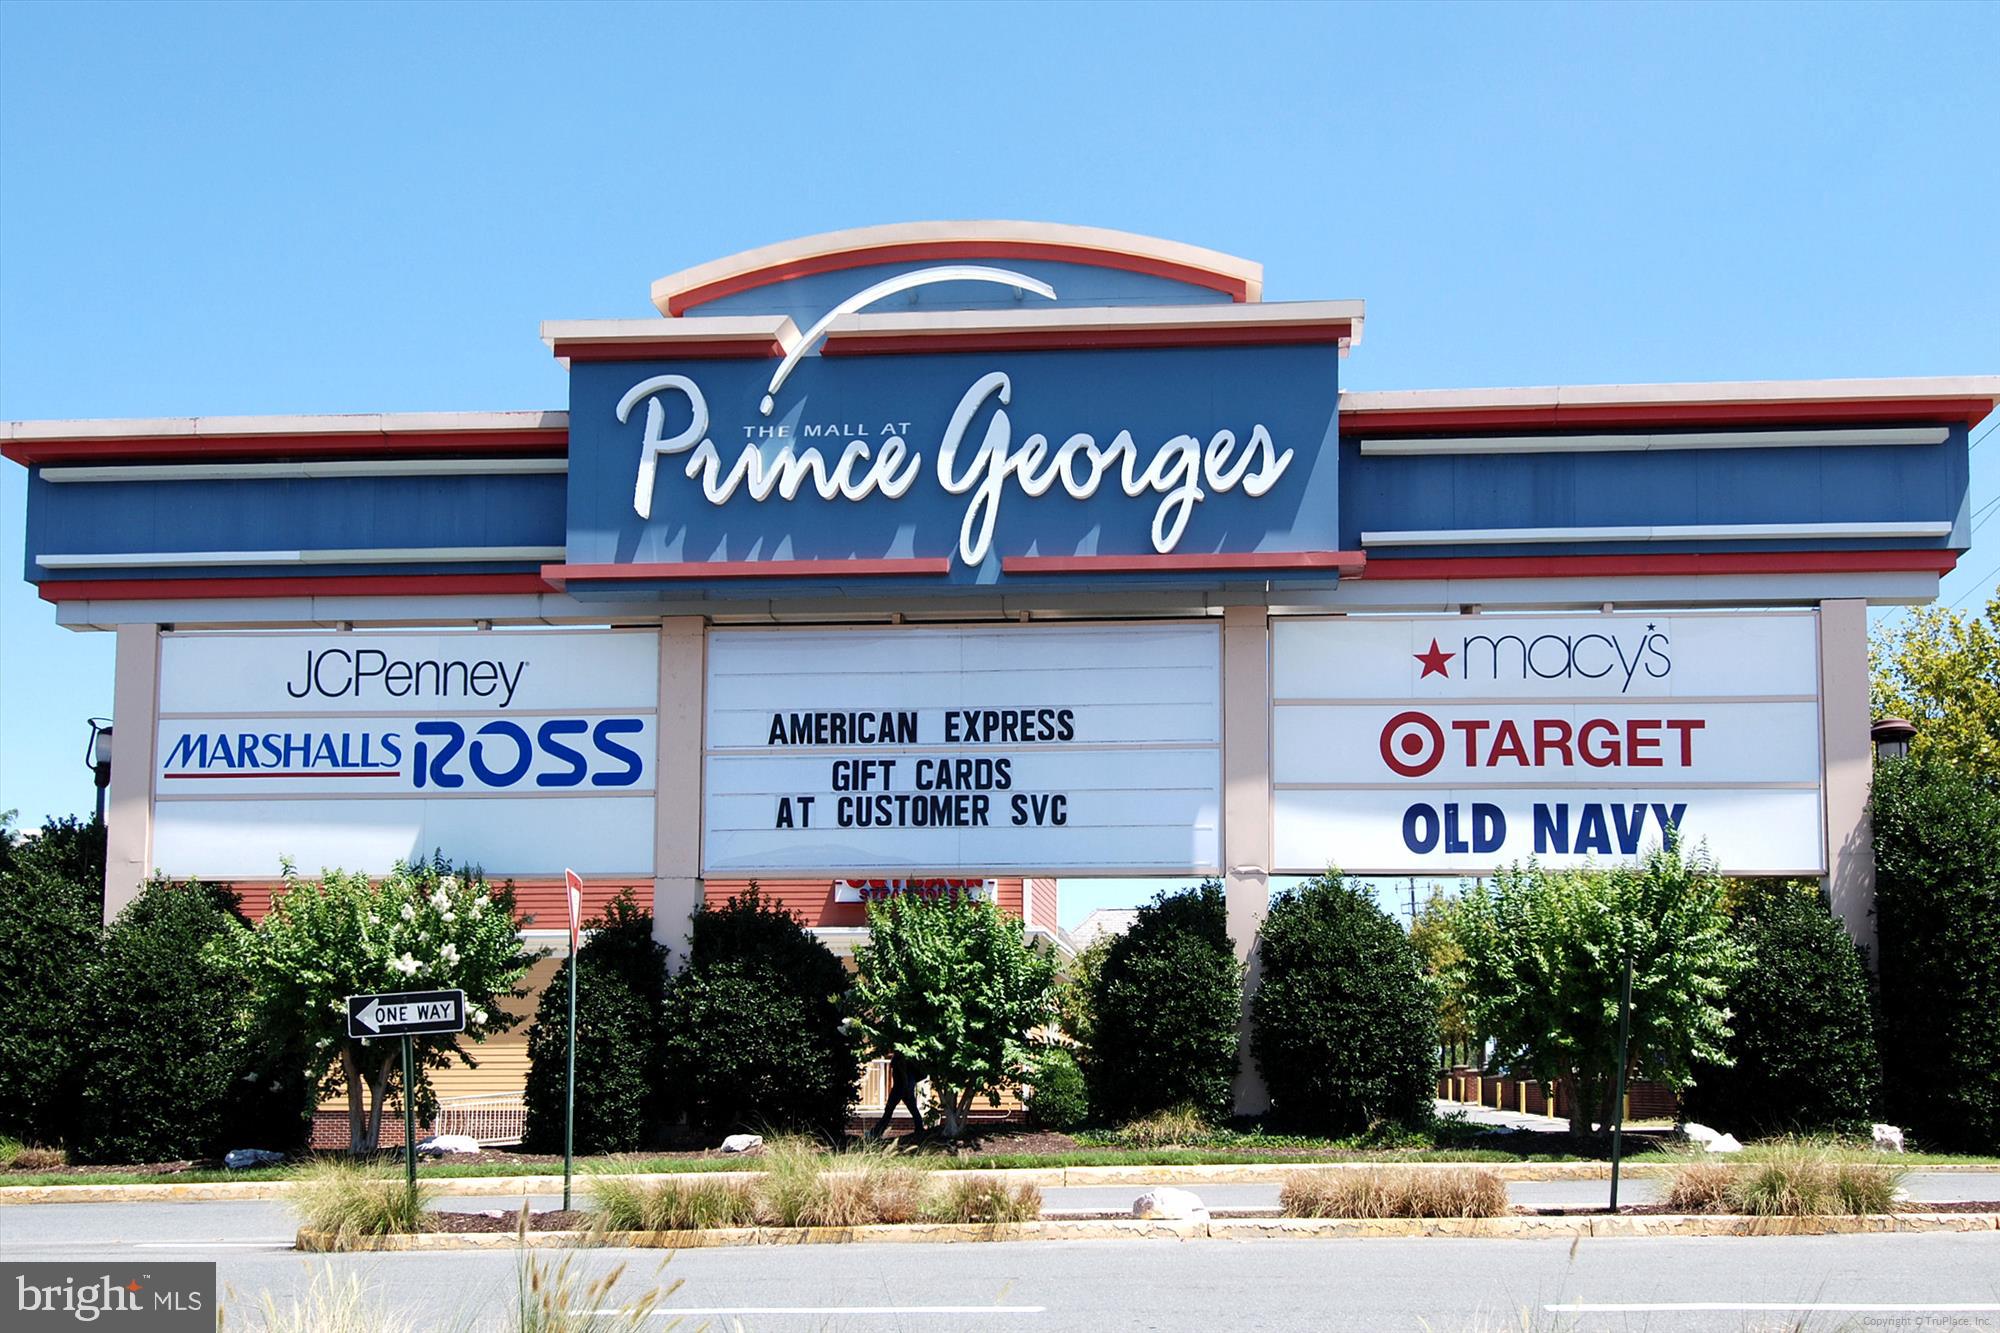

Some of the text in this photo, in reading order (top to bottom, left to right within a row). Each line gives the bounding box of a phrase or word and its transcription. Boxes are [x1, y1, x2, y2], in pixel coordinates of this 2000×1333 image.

[743, 422, 911, 438] THE MALL AT
[616, 371, 1294, 566] Prince Georges
[287, 649, 523, 708] JCPenney
[1463, 622, 1672, 693] macy's
[768, 709, 1075, 746] AMERICAN EXPRESS
[1452, 719, 1706, 767] TARGET
[163, 731, 401, 769] MARSHALLS
[412, 718, 644, 788] ROSS
[832, 757, 1012, 792] GIFT CARDS
[775, 793, 1068, 829] AT CUSTOMER SVC
[1403, 802, 1688, 855] OLD NAVY
[375, 1003, 450, 1023] ONE WAY
